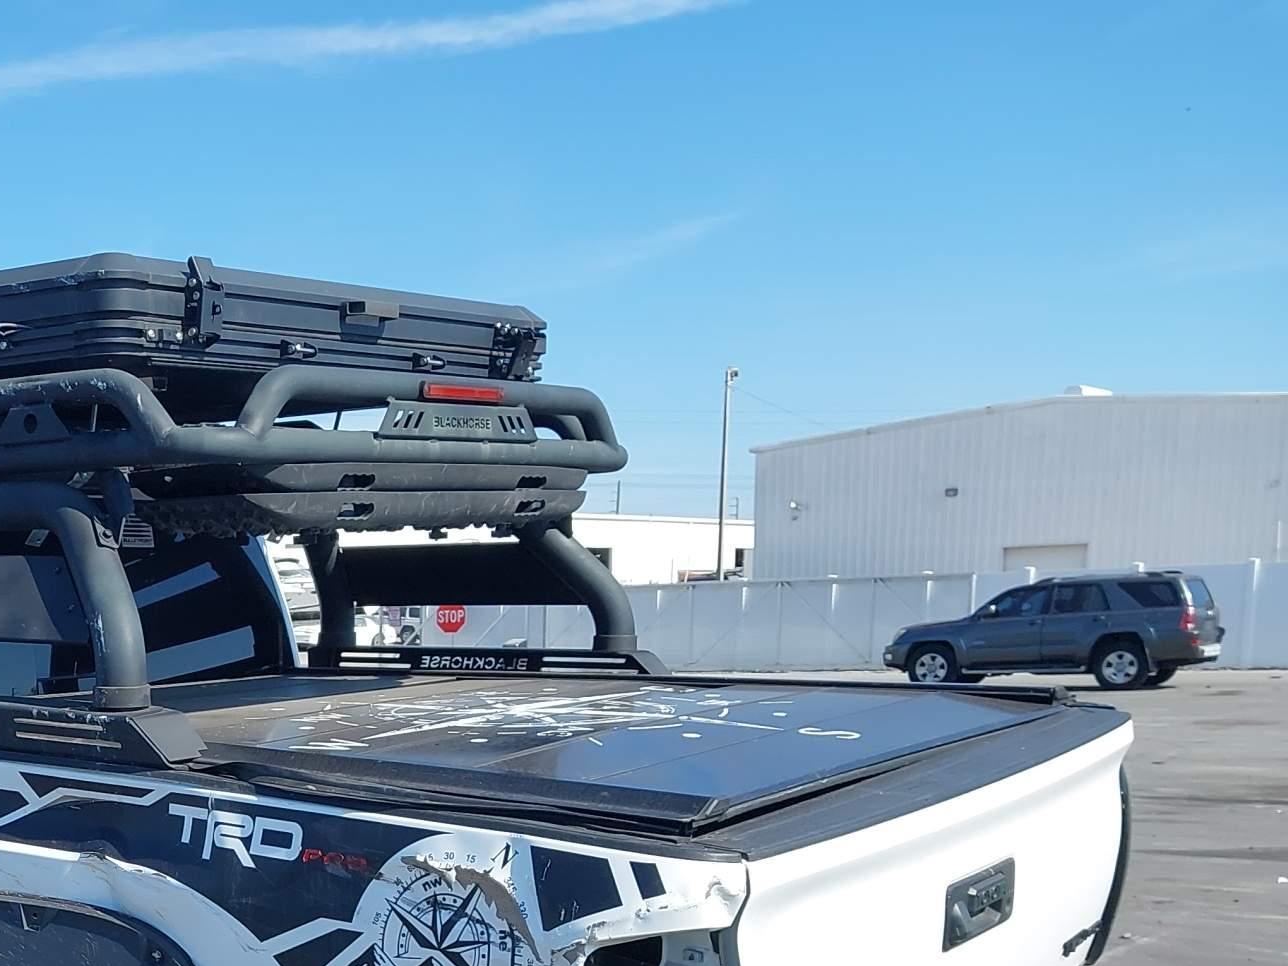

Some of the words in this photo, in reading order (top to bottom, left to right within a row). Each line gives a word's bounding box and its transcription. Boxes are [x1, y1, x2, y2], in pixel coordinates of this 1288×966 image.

[433, 416, 491, 430] BLACKHORSE
[437, 609, 465, 624] STOP
[168, 802, 303, 869] TRD
[466, 854, 477, 864] 15
